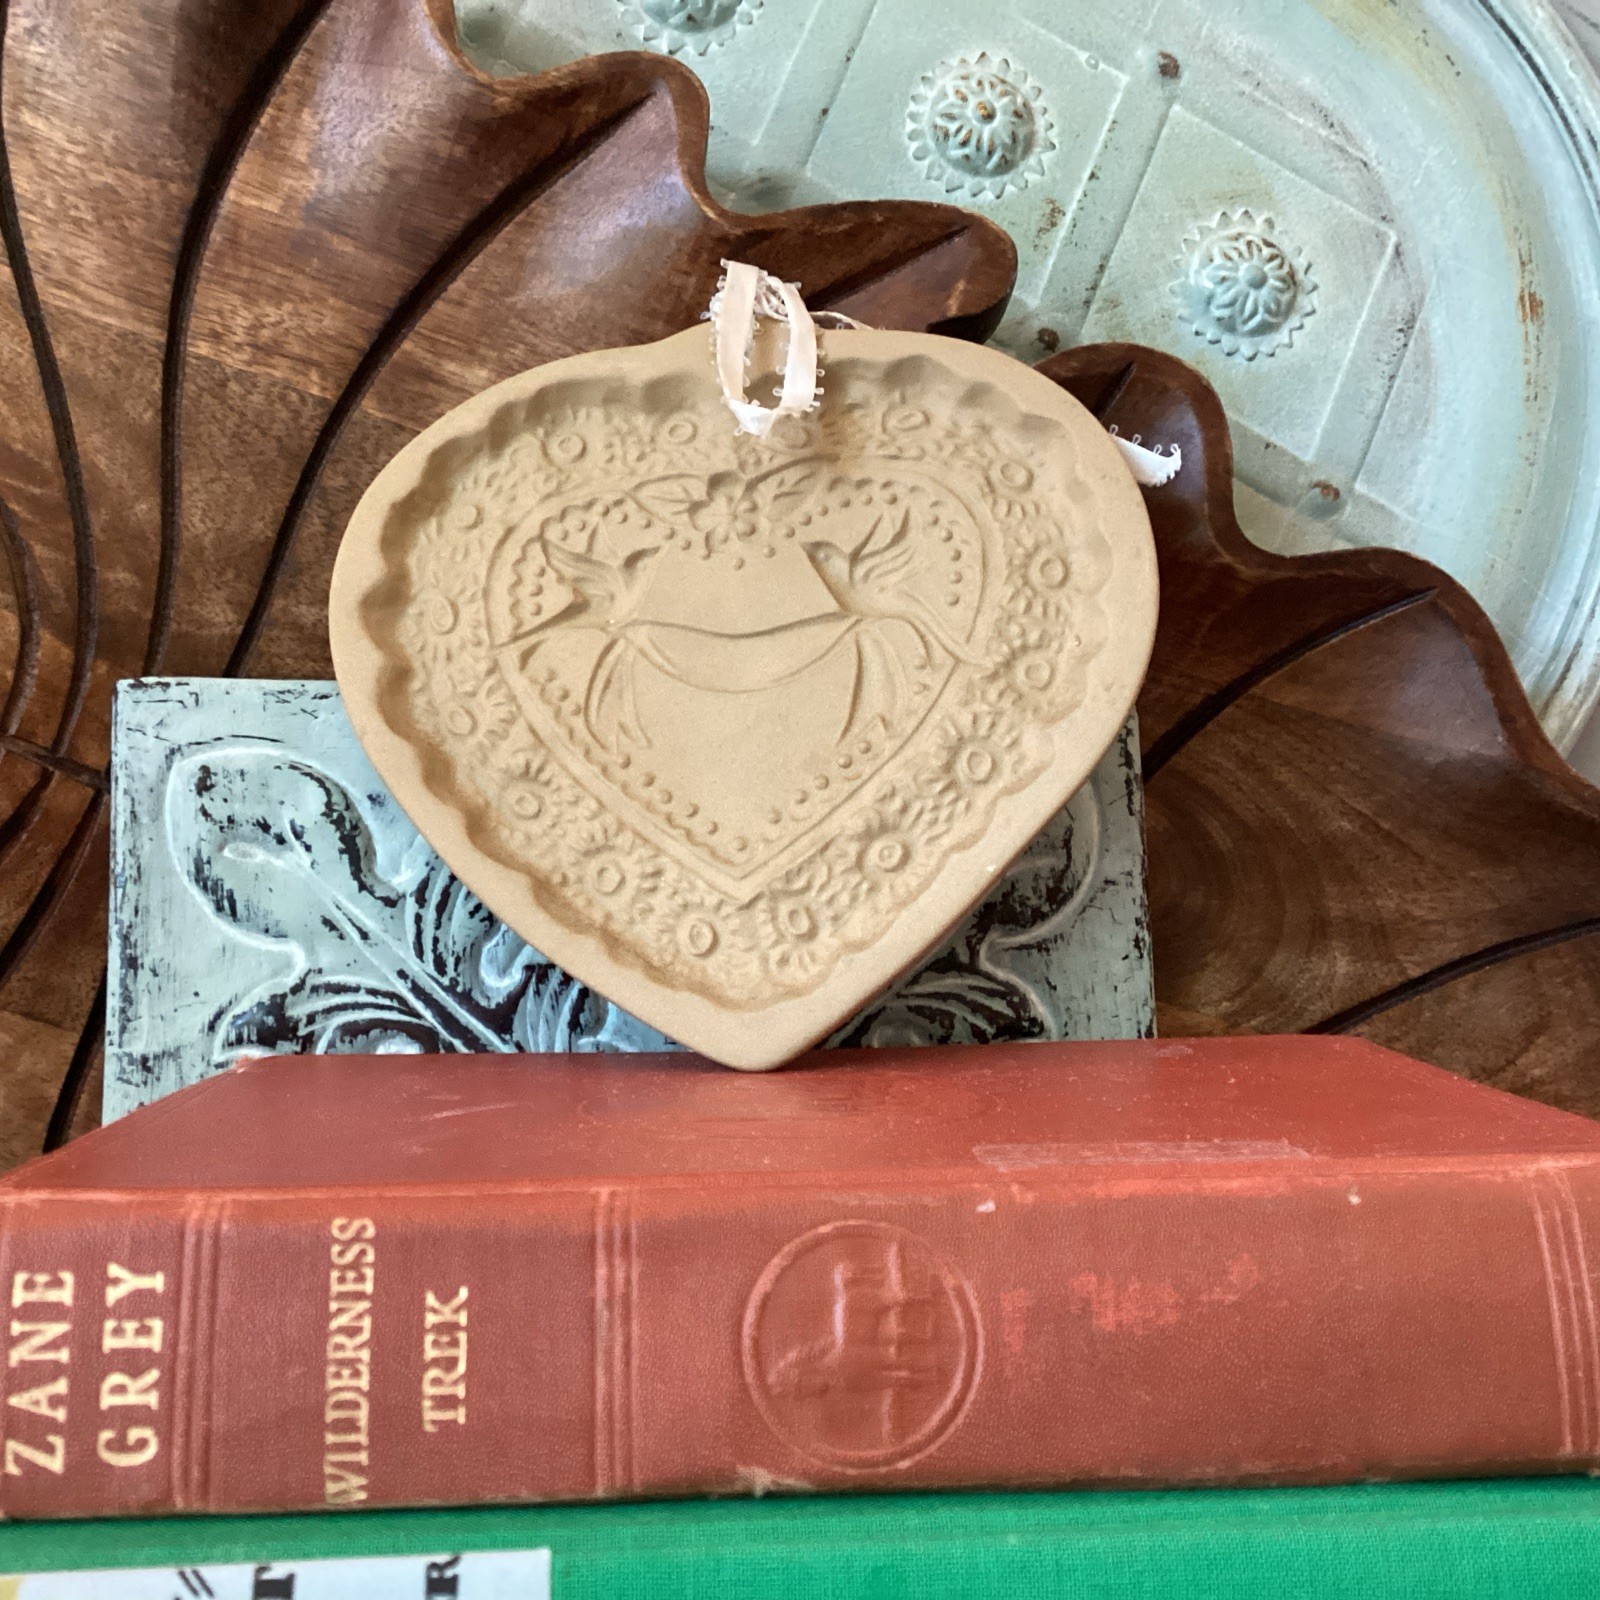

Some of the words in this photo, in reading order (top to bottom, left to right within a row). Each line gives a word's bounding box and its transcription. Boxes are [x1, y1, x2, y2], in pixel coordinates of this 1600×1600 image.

[5, 1269, 75, 1476] ZANE
[98, 1263, 165, 1467] GREY
[323, 1216, 376, 1505] WILDERNESS
[422, 1286, 469, 1432] TREK
